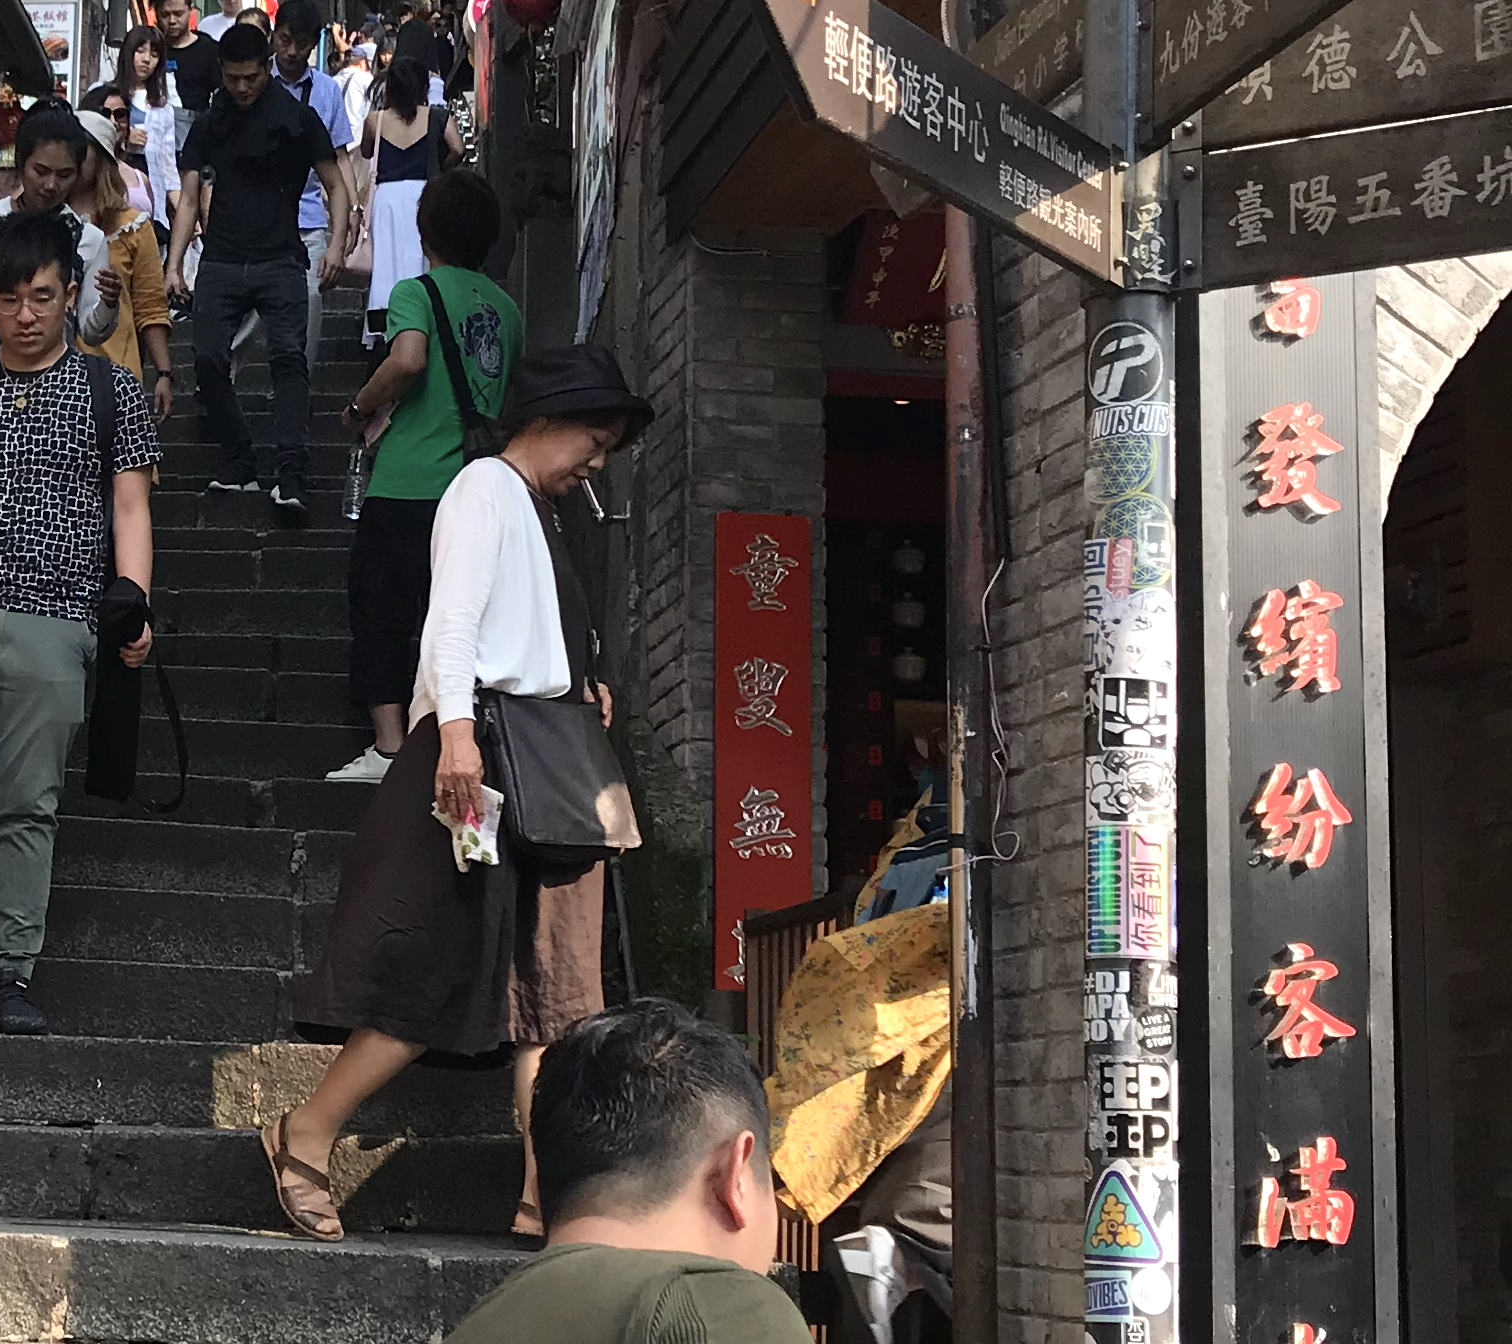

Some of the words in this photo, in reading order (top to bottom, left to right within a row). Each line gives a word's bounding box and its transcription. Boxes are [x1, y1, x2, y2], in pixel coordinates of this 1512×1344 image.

[823, 10, 989, 164] 輕便路遊客中心
[1129, 830, 1163, 952] 你看到了
[1084, 993, 1130, 1019] APA
[1141, 1014, 1163, 1026] LIVE
[1143, 1024, 1172, 1037] GREAT
[1145, 1036, 1173, 1049] STORY
